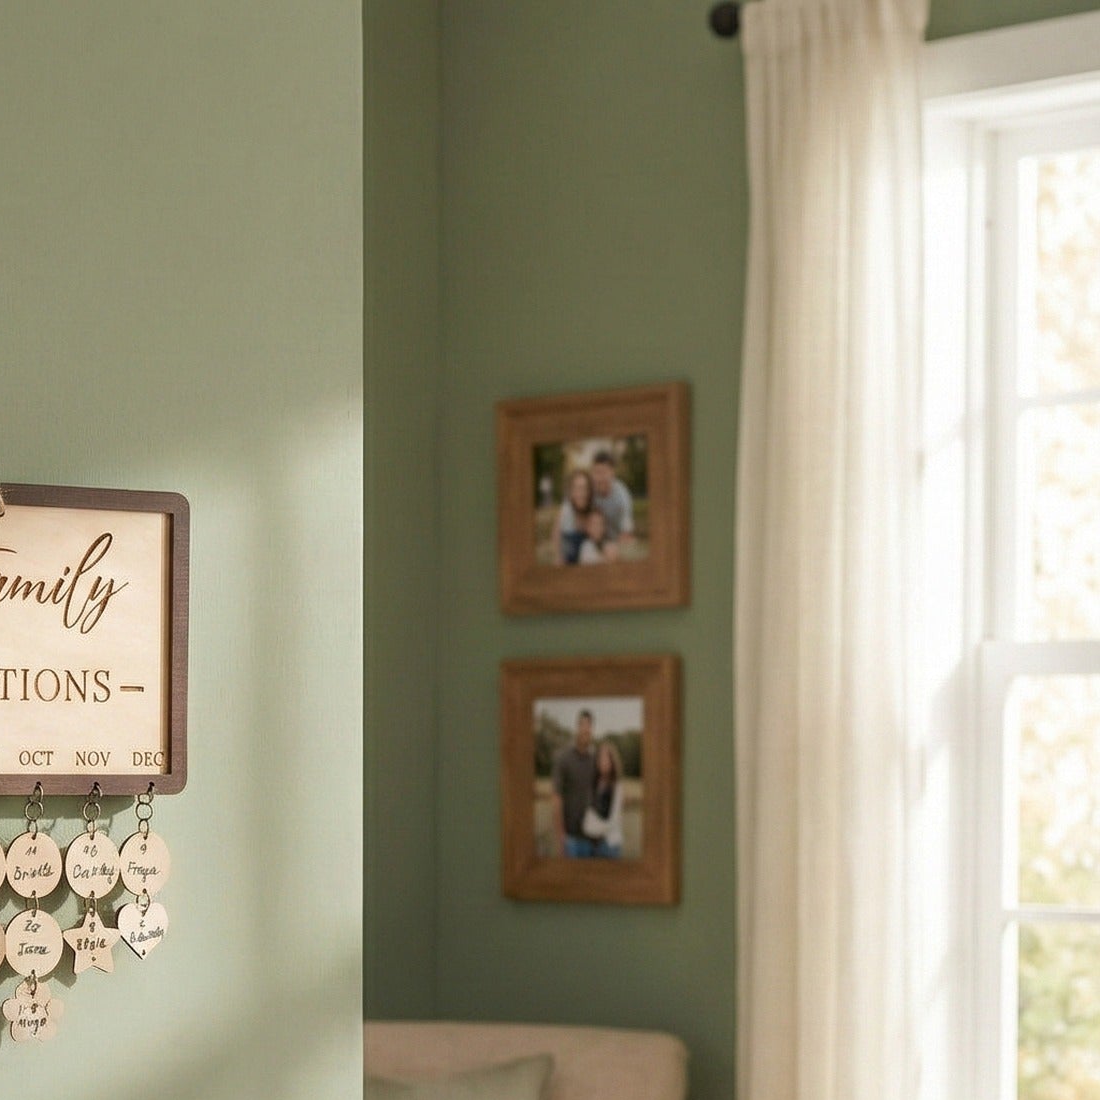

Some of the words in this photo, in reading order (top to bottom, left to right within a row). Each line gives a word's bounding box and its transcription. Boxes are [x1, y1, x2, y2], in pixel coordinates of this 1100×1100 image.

[19, 750, 54, 766] OCT
[75, 751, 111, 767] NOV
[132, 751, 164, 767] DEC
